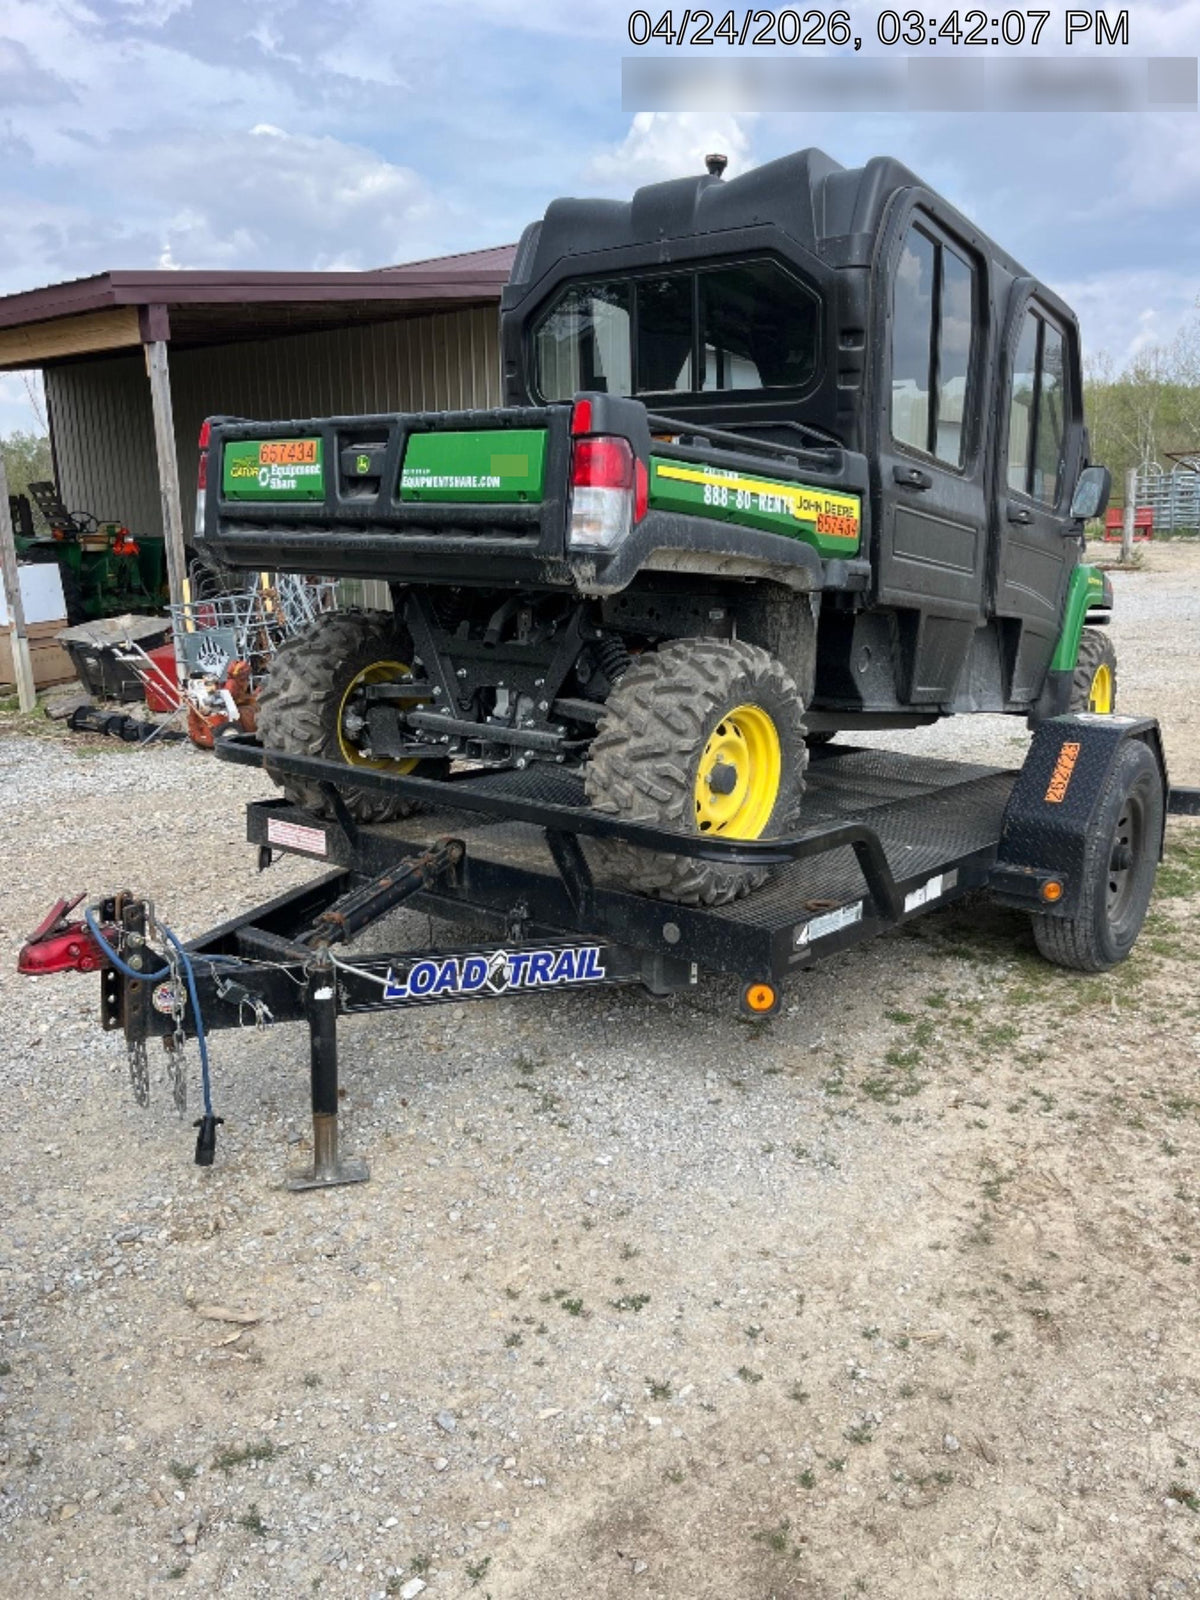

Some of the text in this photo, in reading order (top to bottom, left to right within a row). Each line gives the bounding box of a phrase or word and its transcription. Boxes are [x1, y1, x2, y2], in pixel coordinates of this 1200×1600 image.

[260, 442, 315, 464] 657434
[270, 463, 321, 477] Equipment
[269, 478, 298, 490] Share
[401, 475, 501, 488] EQUIPMENTSHARE.COM
[796, 495, 855, 518] JOHN DEERE
[384, 947, 605, 999] LOAD TRAIL
